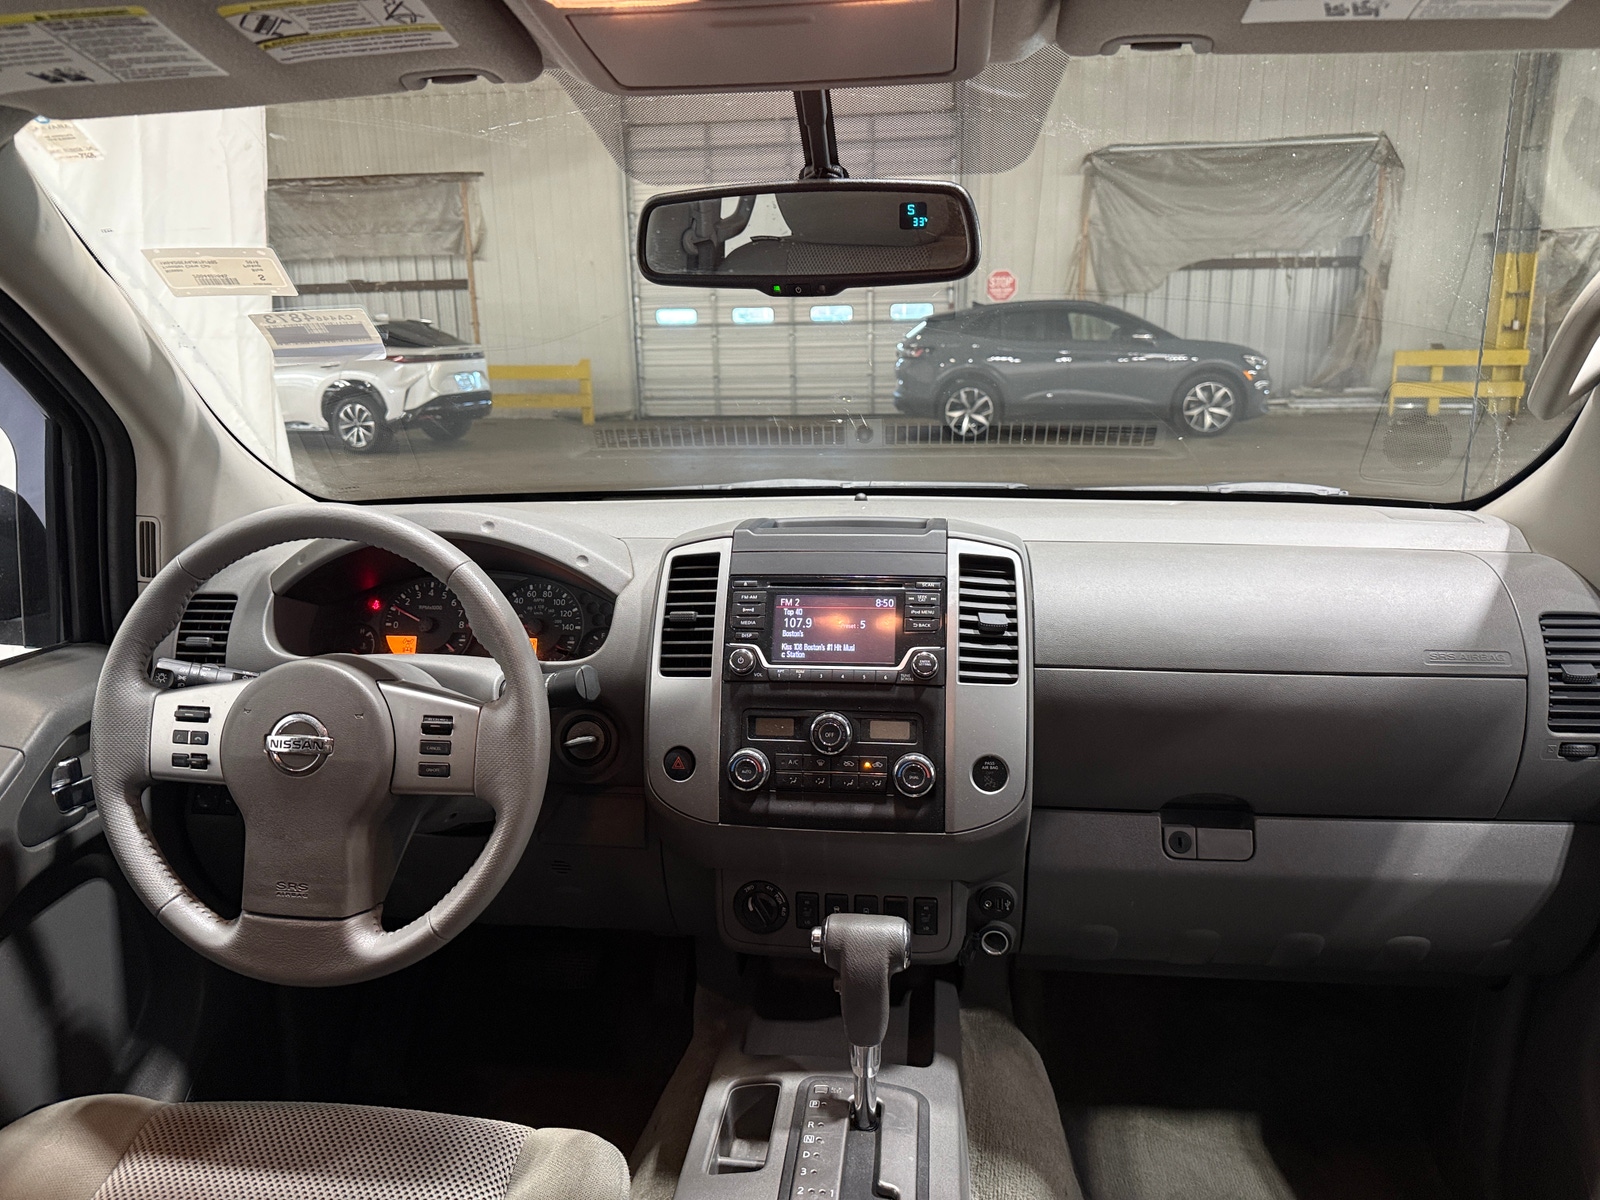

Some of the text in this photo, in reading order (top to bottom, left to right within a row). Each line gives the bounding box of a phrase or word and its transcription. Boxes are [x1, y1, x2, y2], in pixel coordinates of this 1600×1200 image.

[907, 204, 915, 215] S
[989, 277, 1012, 288] STOP
[780, 598, 800, 606] FM 2
[876, 598, 894, 608] 8:50
[784, 618, 812, 628] 107.9
[860, 620, 866, 629] 5
[1429, 652, 1505, 661] SRS AIRBAG
[269, 739, 324, 750] NISSAN
[276, 881, 308, 892] SRS
[797, 1187, 804, 1195] 2
